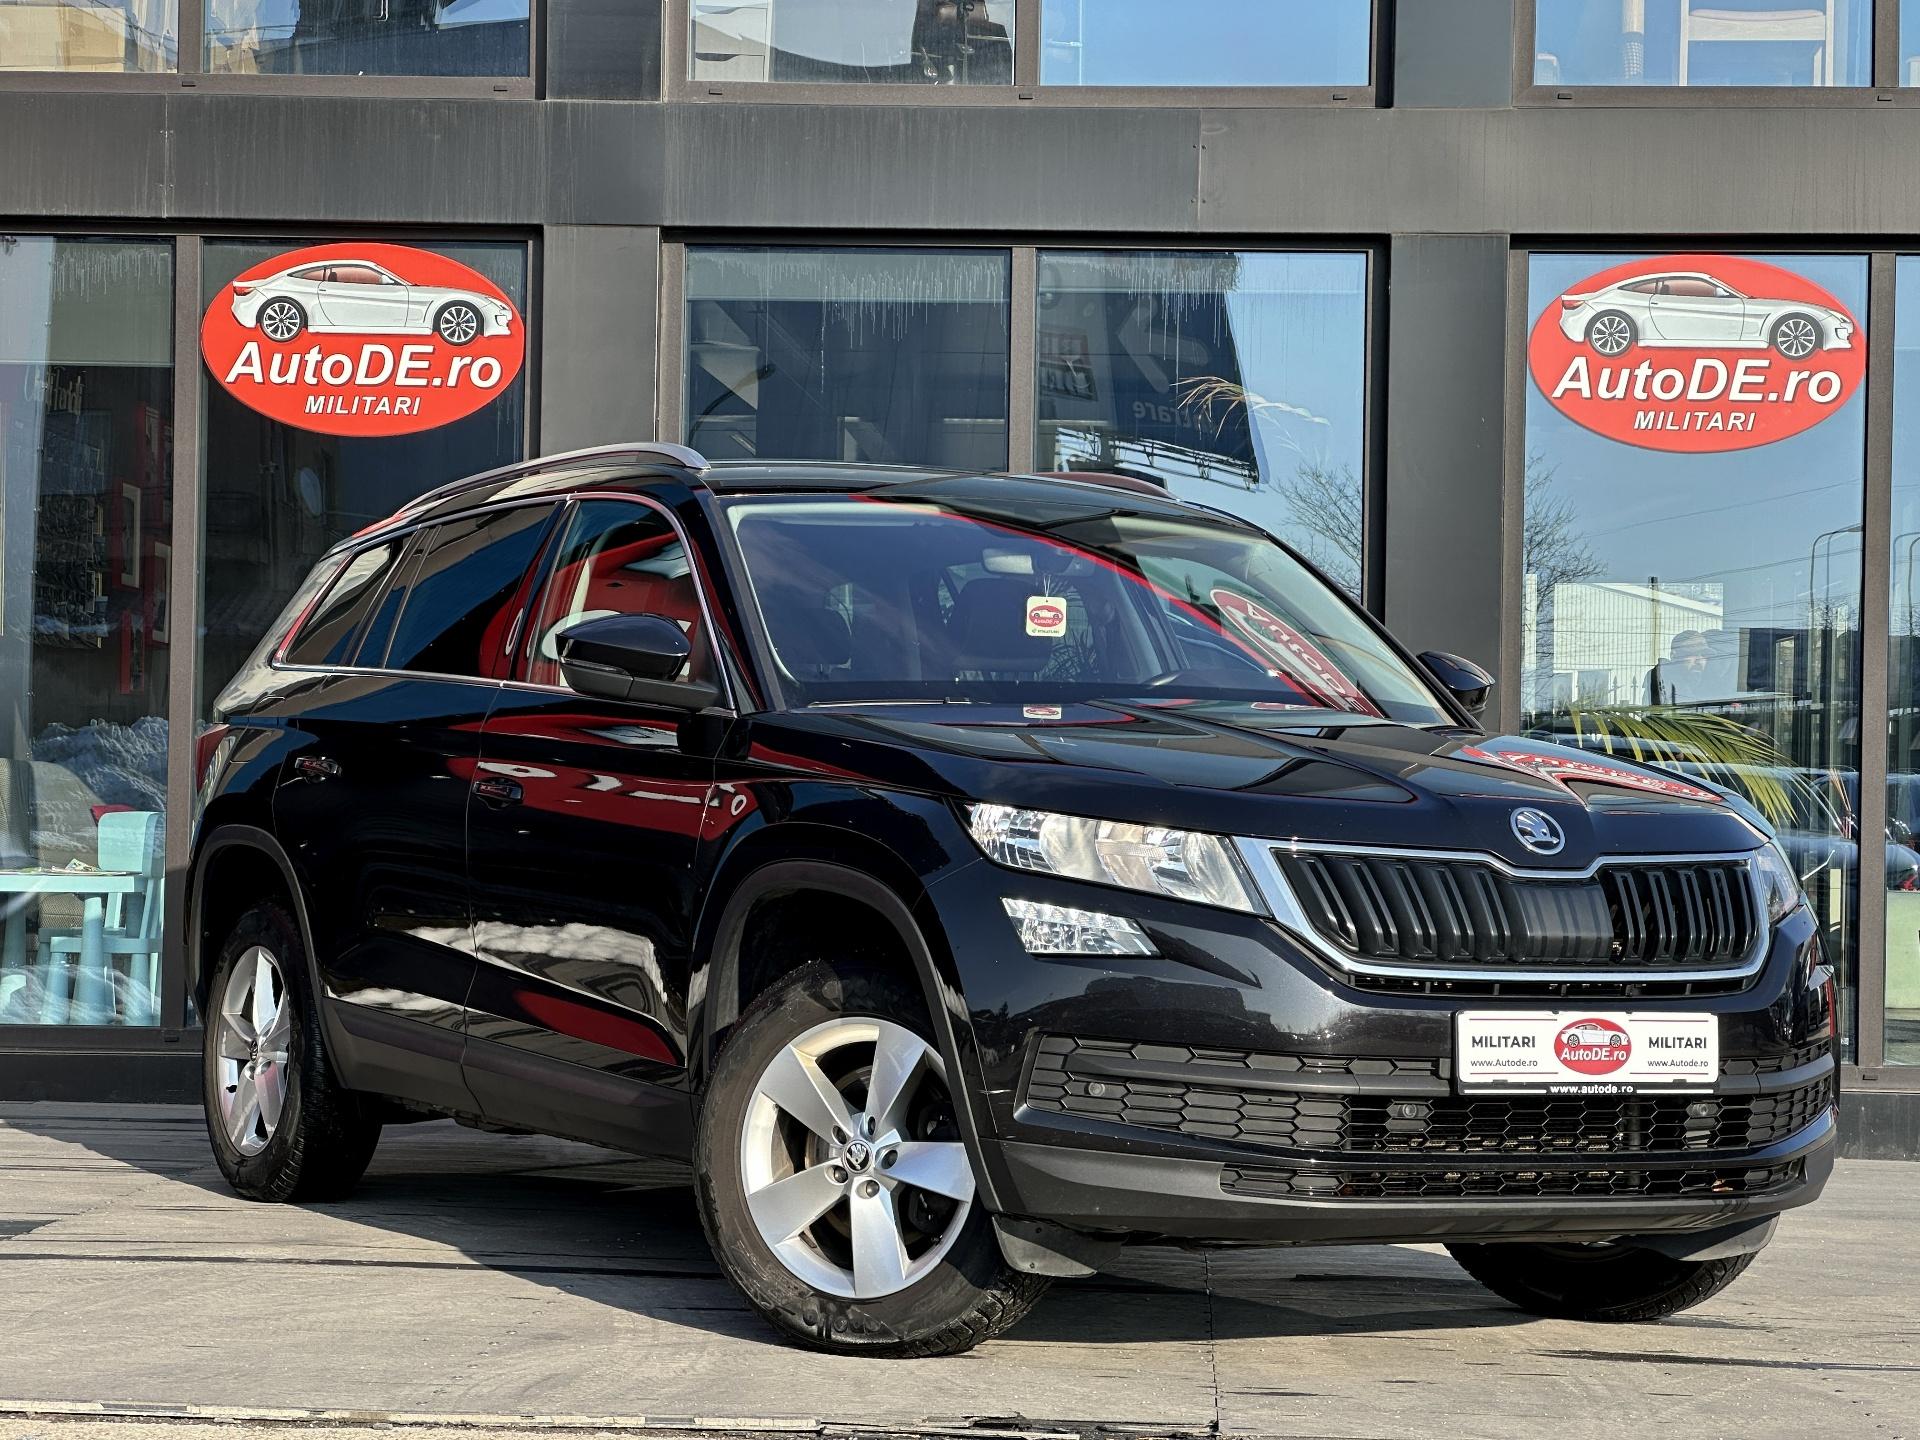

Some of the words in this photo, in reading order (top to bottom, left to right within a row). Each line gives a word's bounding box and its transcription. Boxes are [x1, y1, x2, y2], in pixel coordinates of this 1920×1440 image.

[224, 341, 503, 389] AutoDE.ro
[1551, 356, 1842, 404] AutoDE.ro
[304, 395, 421, 416] MILITARI
[1633, 410, 1756, 432] MILITARI
[1471, 1035, 1536, 1048] MILITARI
[1648, 1036, 1707, 1049] MILITARI
[1560, 1047, 1627, 1062] AutoDE.ro
[1470, 1058, 1538, 1067] www.Autode.ro
[1647, 1058, 1709, 1068] www.Autode.ro
[1549, 1083, 1634, 1094] www.autode.ro
